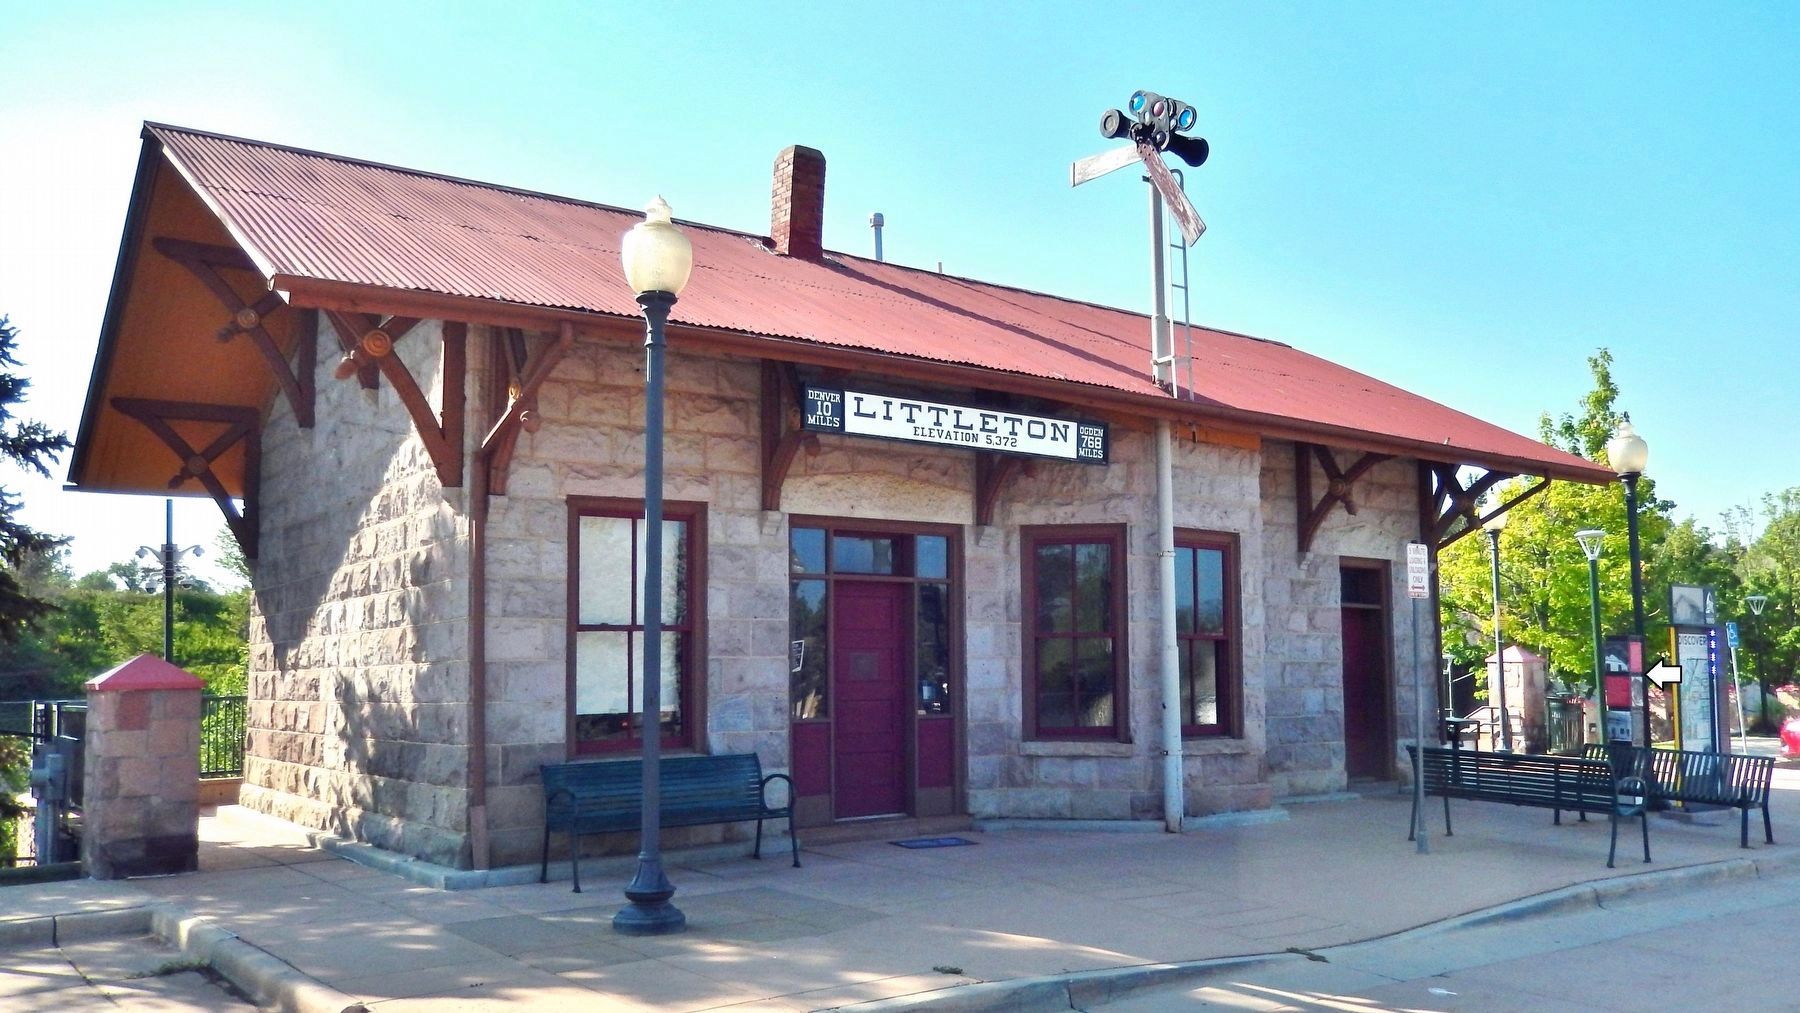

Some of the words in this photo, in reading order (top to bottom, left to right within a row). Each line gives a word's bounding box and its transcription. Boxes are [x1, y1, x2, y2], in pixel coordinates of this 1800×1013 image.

[808, 390, 840, 403] DENVER
[816, 400, 832, 416] 10
[807, 414, 840, 427] MILES
[854, 396, 1070, 443] LITTLETON
[913, 426, 979, 443] ELEVATION
[1079, 426, 1104, 437] OGDEN
[1081, 435, 1102, 449] 768
[1078, 447, 1104, 459] MILES
[1678, 635, 1707, 645] DISCOVER
